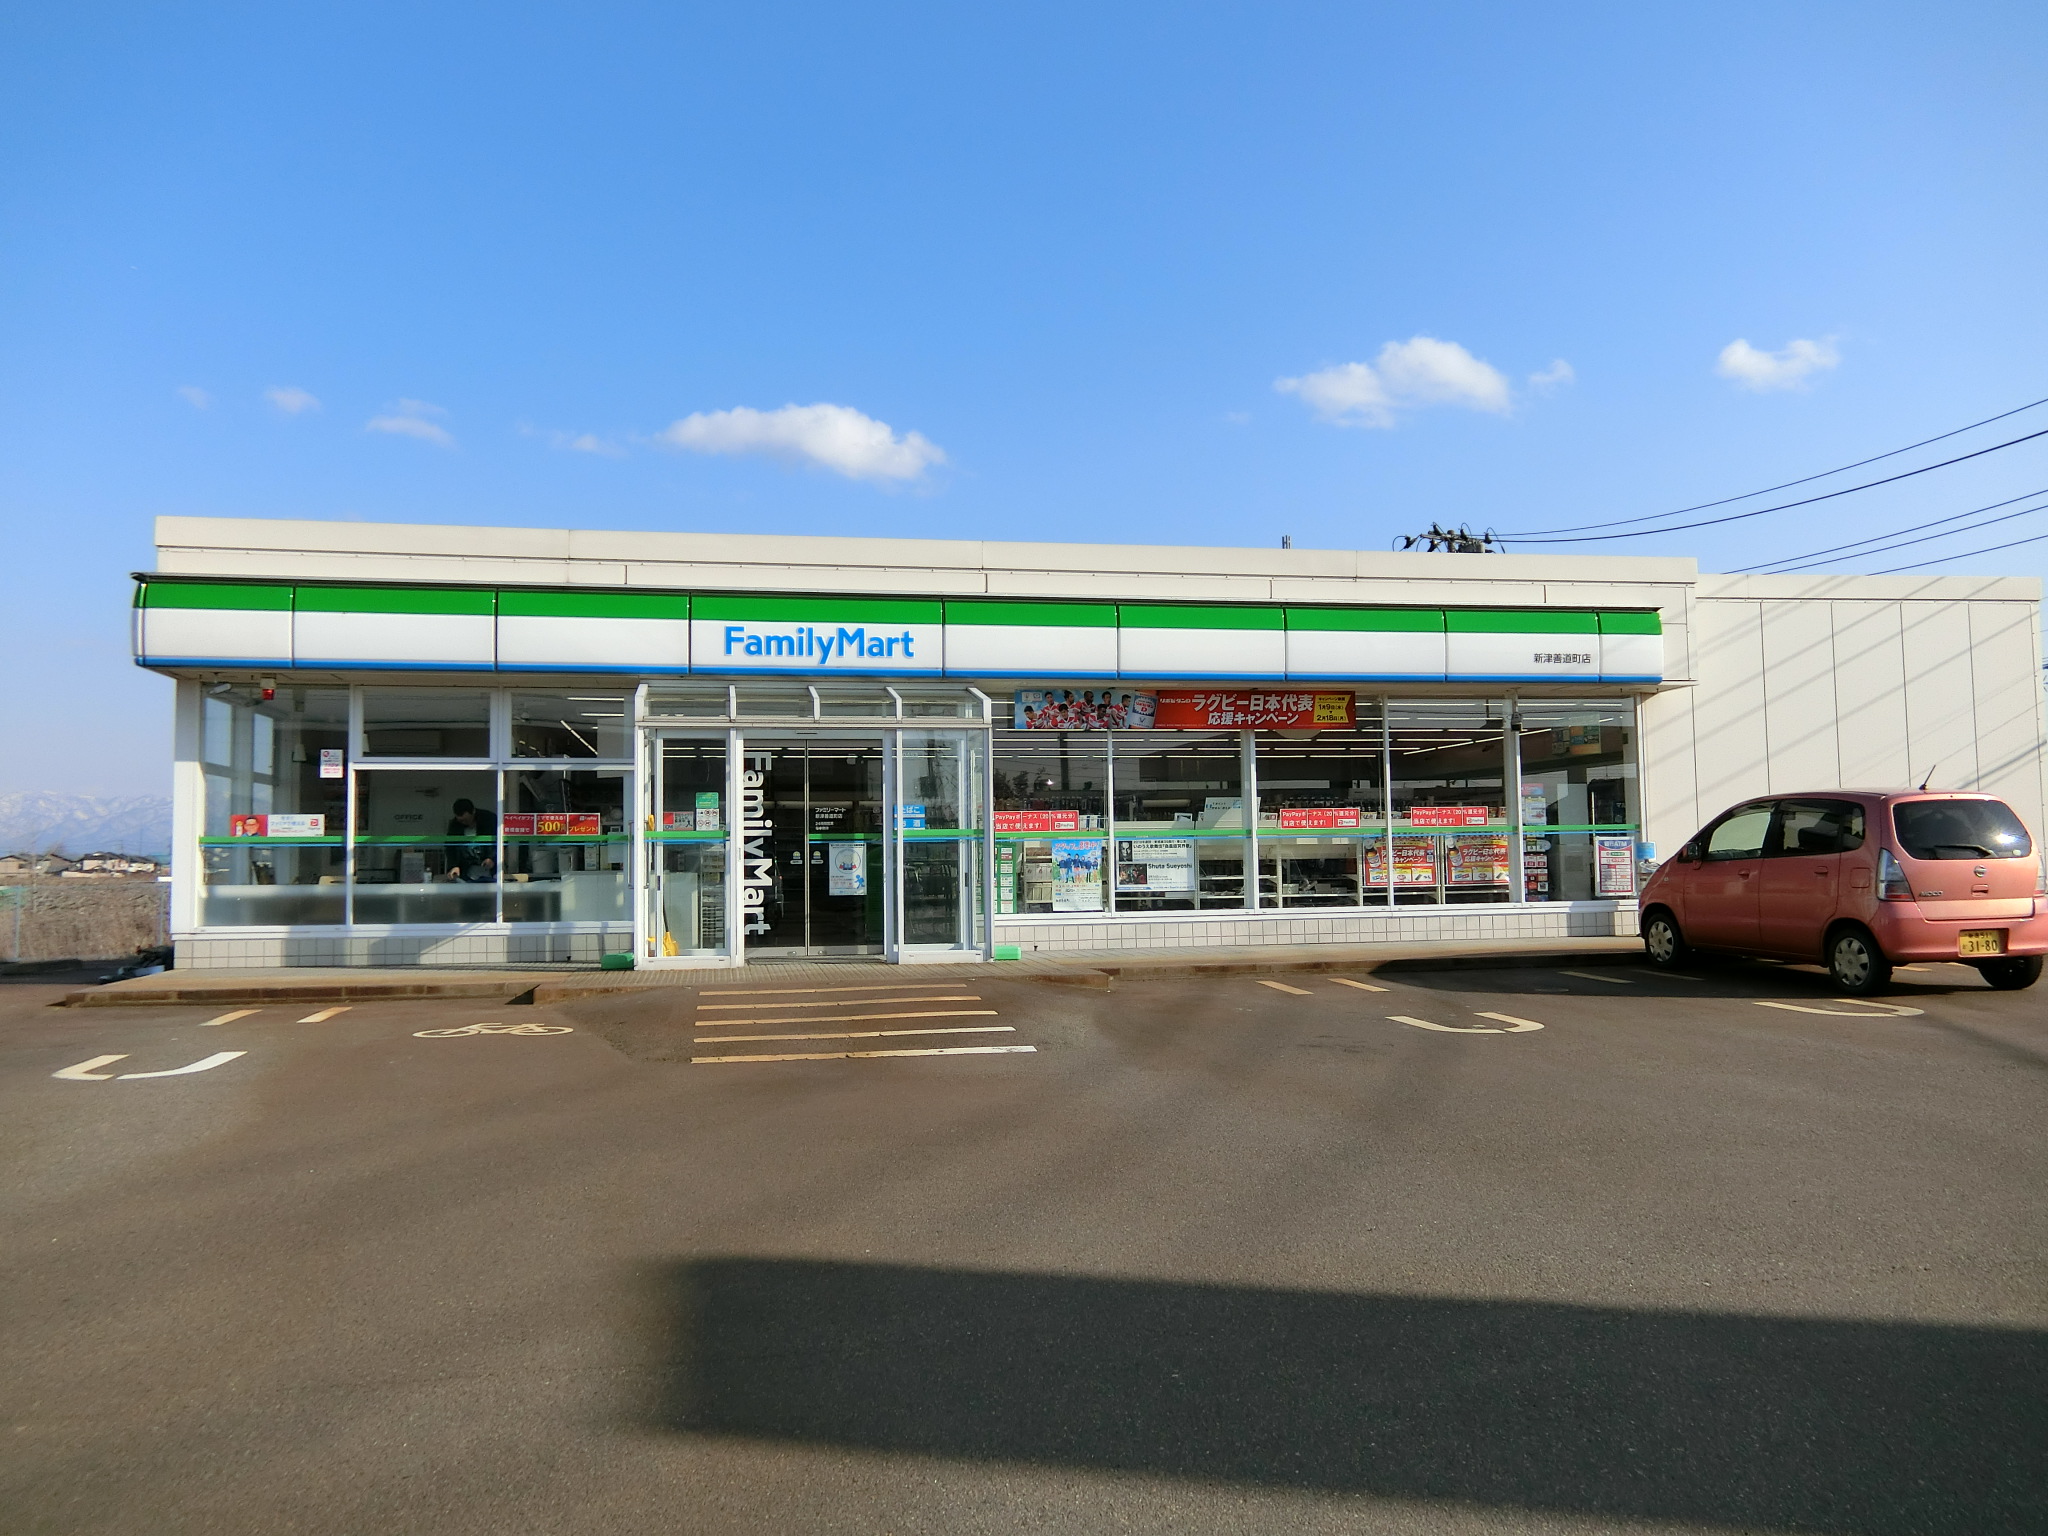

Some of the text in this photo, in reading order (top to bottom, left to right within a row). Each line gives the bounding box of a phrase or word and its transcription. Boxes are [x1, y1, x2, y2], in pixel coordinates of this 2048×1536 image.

[724, 626, 915, 665] FamilyMart
[1534, 653, 1591, 663] 新津善道町店
[1191, 693, 1314, 712] ラグビー日本代表
[1207, 711, 1299, 725] 応援キャンペーン
[743, 751, 773, 935] FamilyMart
[1968, 940, 1998, 952] 31-80
